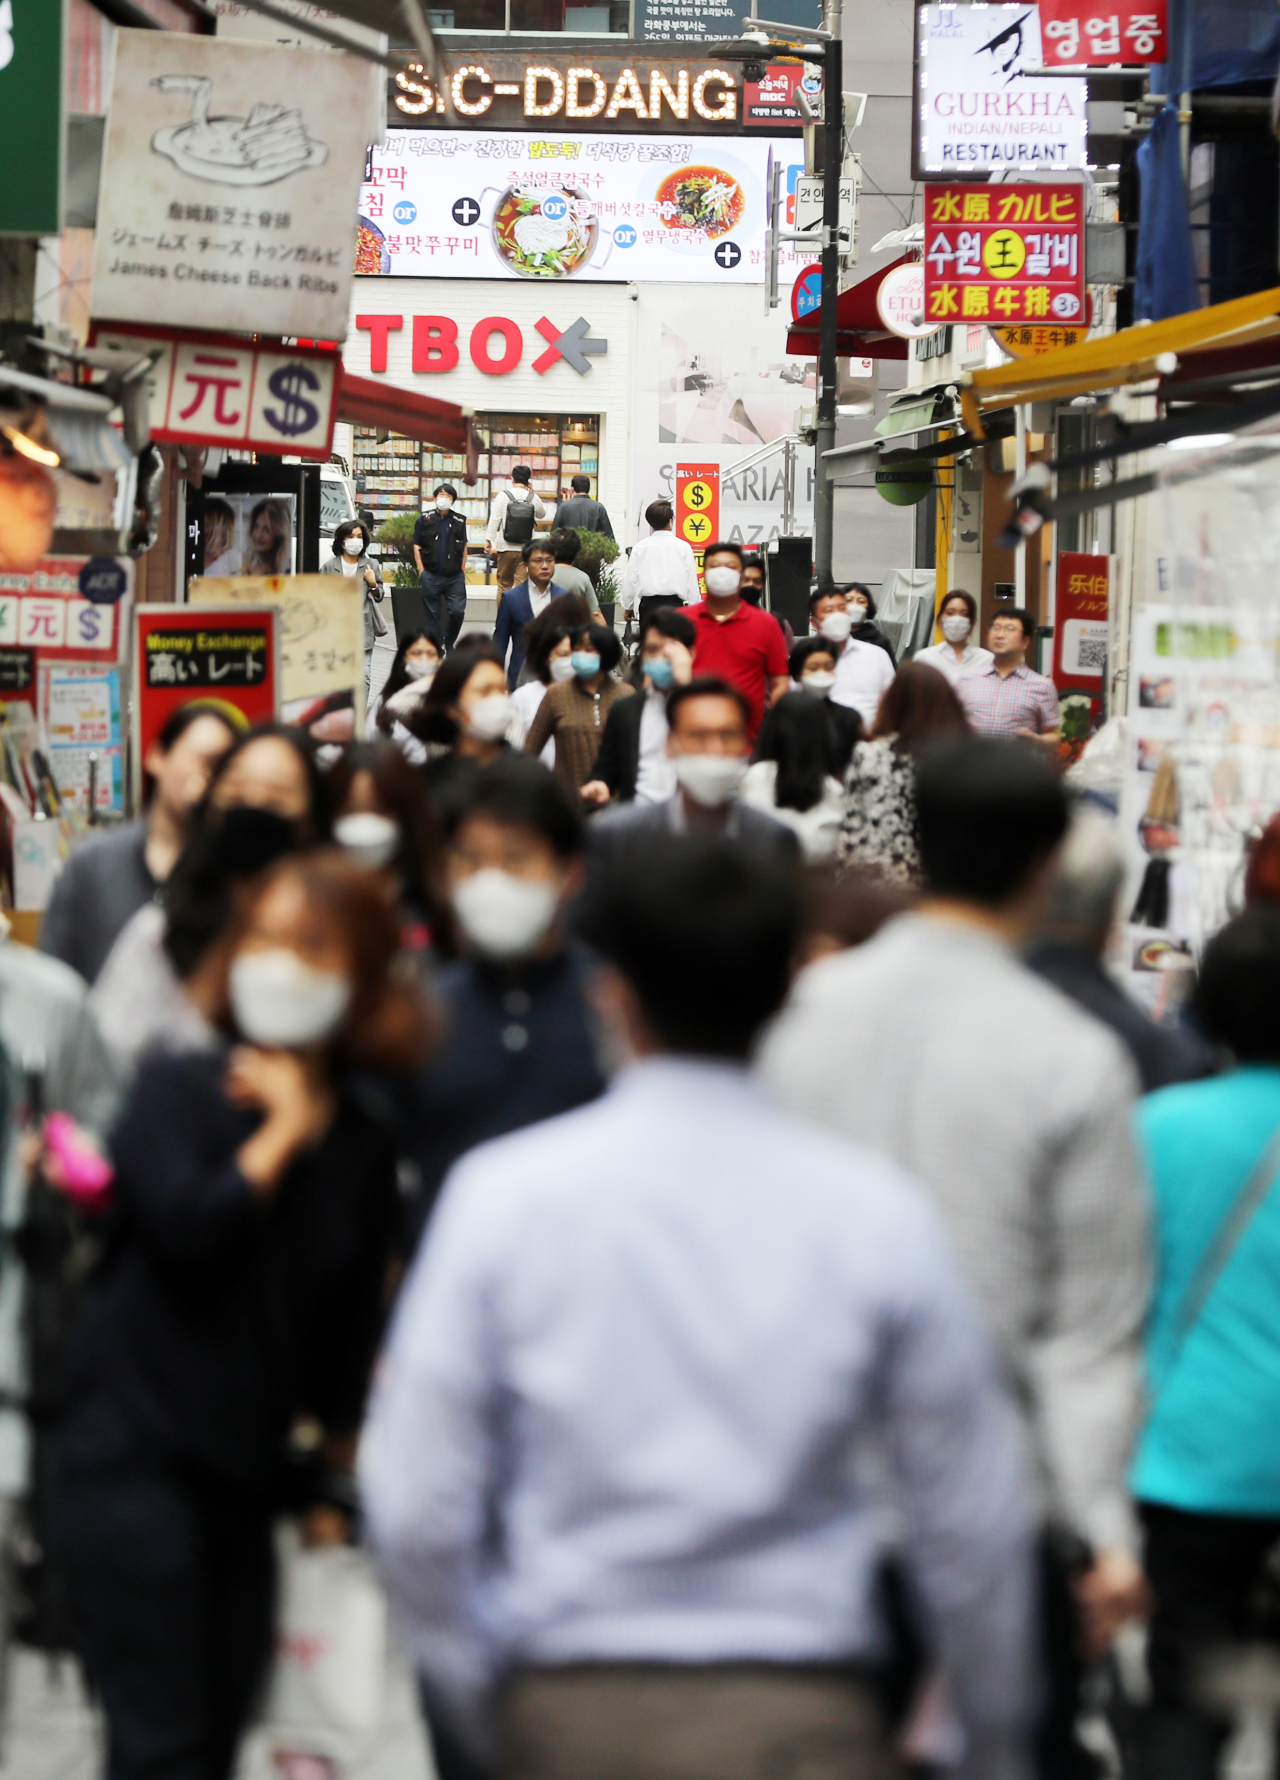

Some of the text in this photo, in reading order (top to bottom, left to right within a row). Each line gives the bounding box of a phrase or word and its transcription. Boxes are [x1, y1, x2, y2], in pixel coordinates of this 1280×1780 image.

[930, 29, 965, 38] HALAL
[1045, 14, 1162, 59] 영업중
[760, 92, 786, 102] MBC
[934, 92, 1077, 117] GURKHA
[948, 122, 1063, 135] INDIAN/NEPALI
[477, 140, 525, 159] 진정한
[528, 141, 582, 159] 밥도둑!
[586, 143, 635, 161] 더식당
[637, 144, 693, 162] 꿀조합!
[943, 143, 1069, 161] RESTAURANT
[506, 170, 606, 189] 즉석얼큰칼국수
[800, 188, 850, 203] 견인역
[394, 205, 417, 220] or
[544, 202, 566, 215] or
[575, 200, 677, 219] 들깨버섯칼국수
[997, 193, 1077, 222] カルビ
[614, 229, 636, 243] or
[642, 229, 708, 245] 열무냉국수
[109, 257, 340, 294] James Cheese Back Ribs
[888, 296, 922, 310] ETU
[929, 283, 1051, 317] 水原牛排
[355, 314, 607, 376] TBOX
[178, 354, 321, 437] 元 $
[1069, 574, 1108, 595] 乐伯
[146, 632, 267, 654] Money Exchange
[148, 651, 199, 683] 高い
[208, 652, 263, 682] レート
